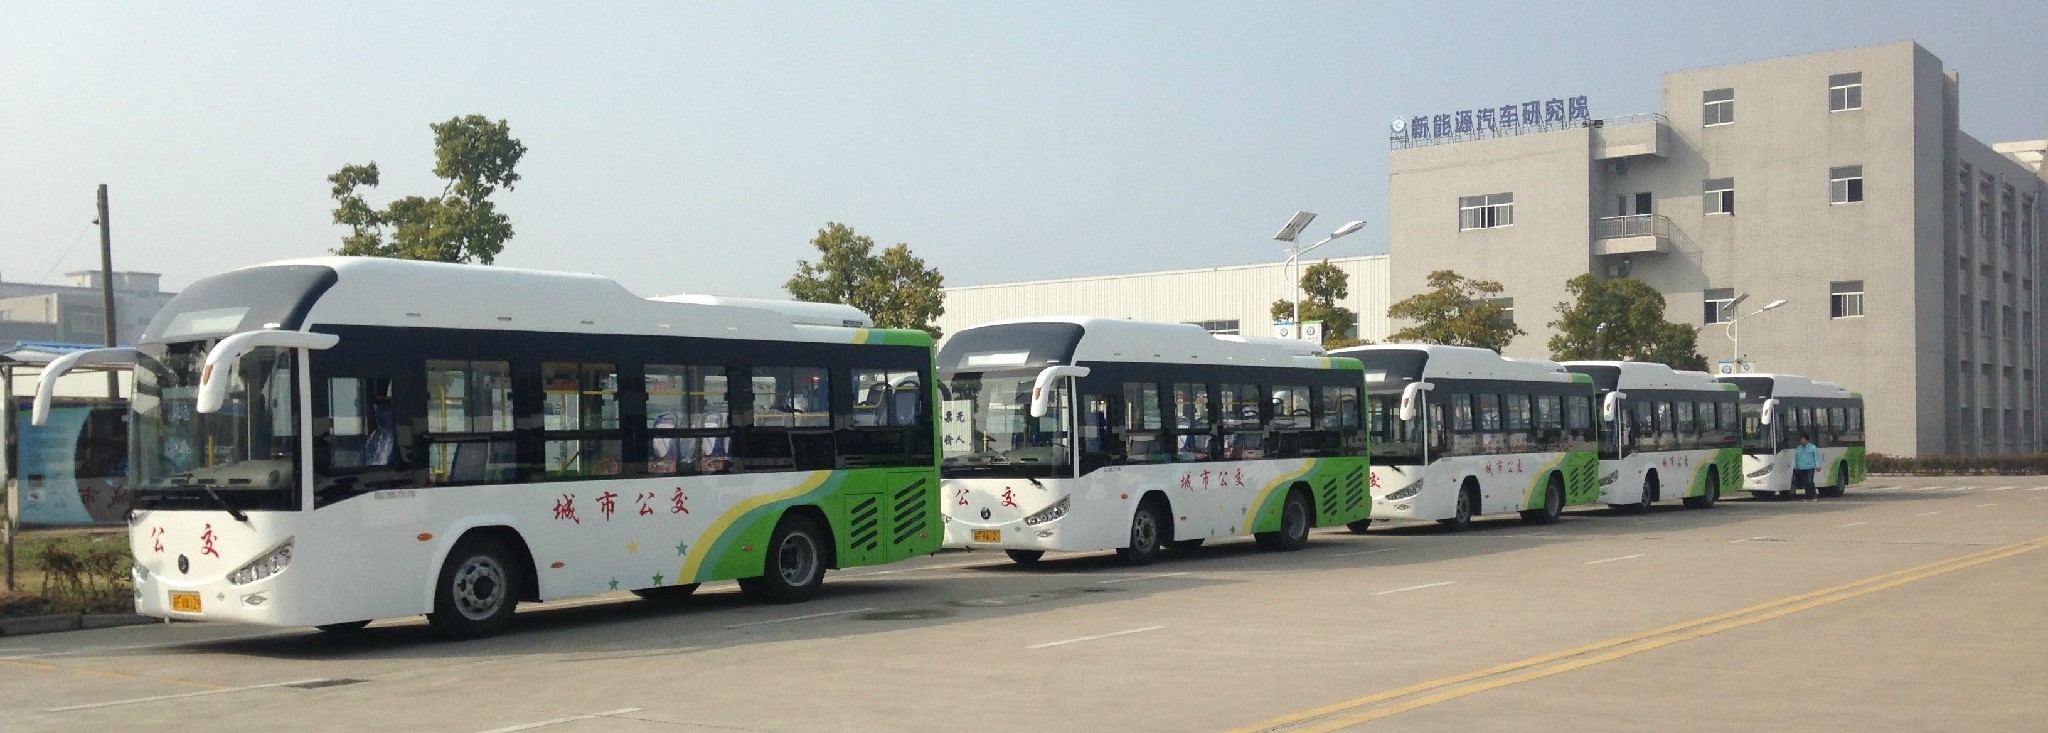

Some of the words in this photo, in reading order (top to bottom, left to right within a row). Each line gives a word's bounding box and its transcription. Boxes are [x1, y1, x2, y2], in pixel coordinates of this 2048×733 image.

[1411, 95, 1588, 139] 新能源汽车研究院
[1180, 468, 1244, 492] 城市公交
[553, 487, 689, 525] 城市公交
